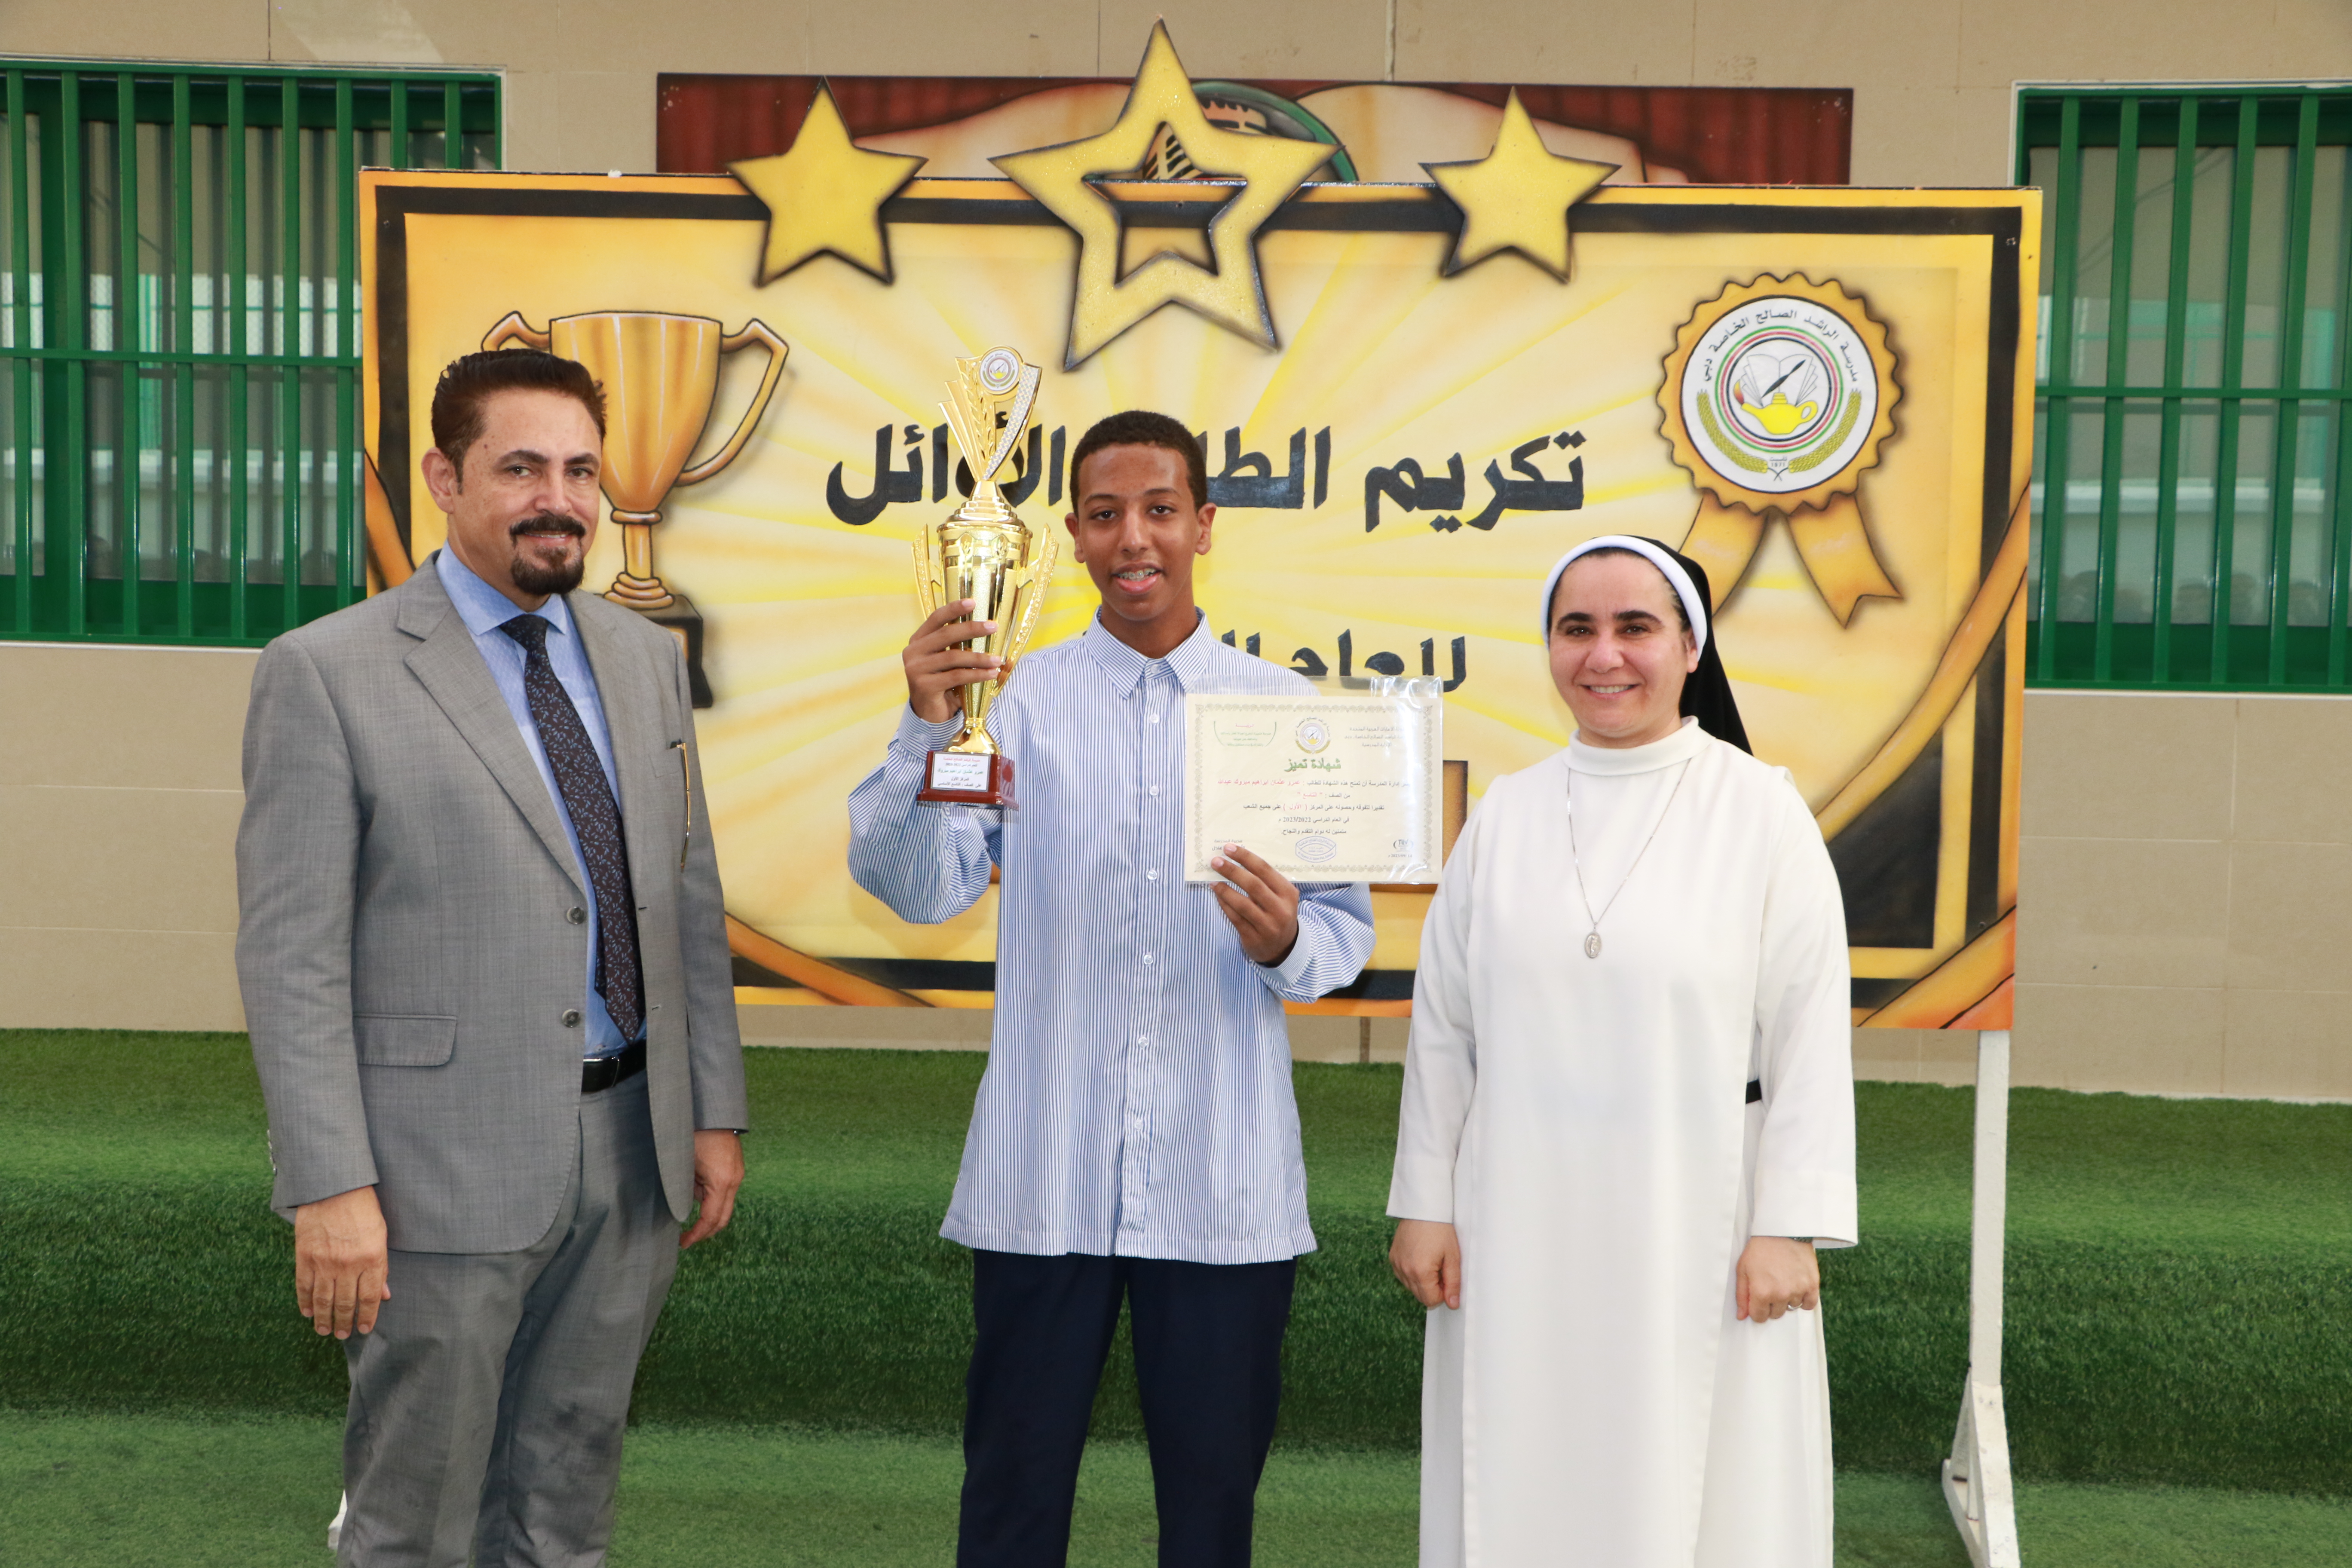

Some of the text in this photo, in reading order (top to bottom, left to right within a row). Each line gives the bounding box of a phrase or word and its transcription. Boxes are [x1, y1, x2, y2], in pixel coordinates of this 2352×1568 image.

[1755, 309, 1797, 324] الصالح
[1709, 317, 1750, 353] الخاصة
[1195, 426, 1331, 509] الط
[1365, 430, 1587, 533] تكريم
[1284, 757, 1341, 772] شهادة تميز
